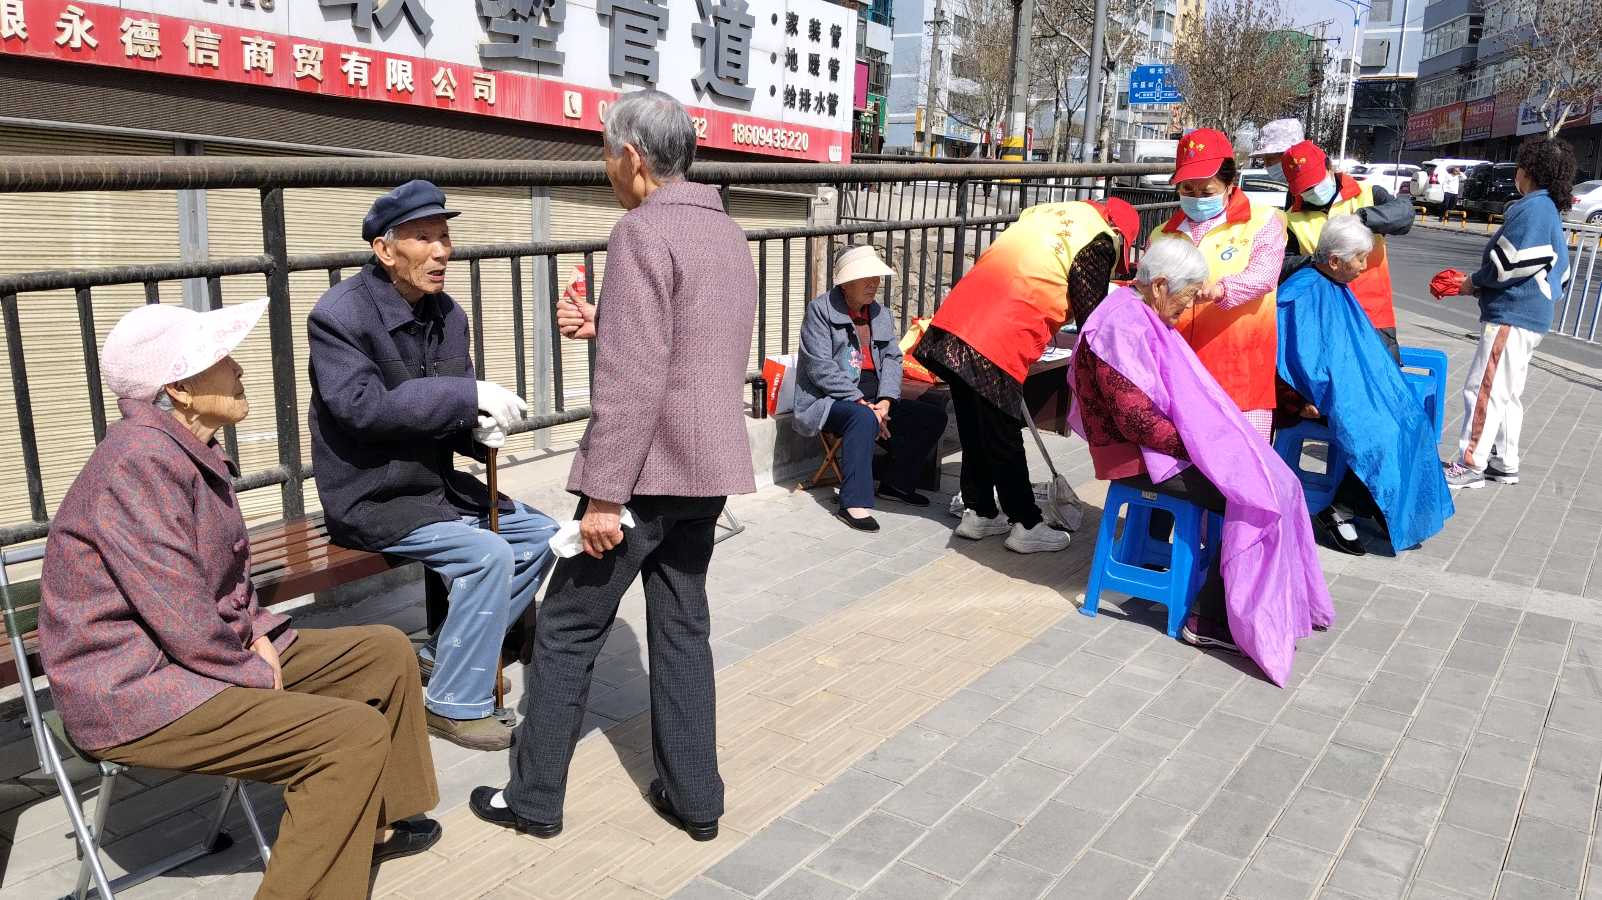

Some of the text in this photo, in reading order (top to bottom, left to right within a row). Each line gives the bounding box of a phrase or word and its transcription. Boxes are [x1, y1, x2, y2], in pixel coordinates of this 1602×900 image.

[785, 11, 842, 49] 家装管
[784, 47, 840, 83] 地暖管
[783, 83, 839, 118] 给排水管
[732, 123, 810, 152] 18609435220
